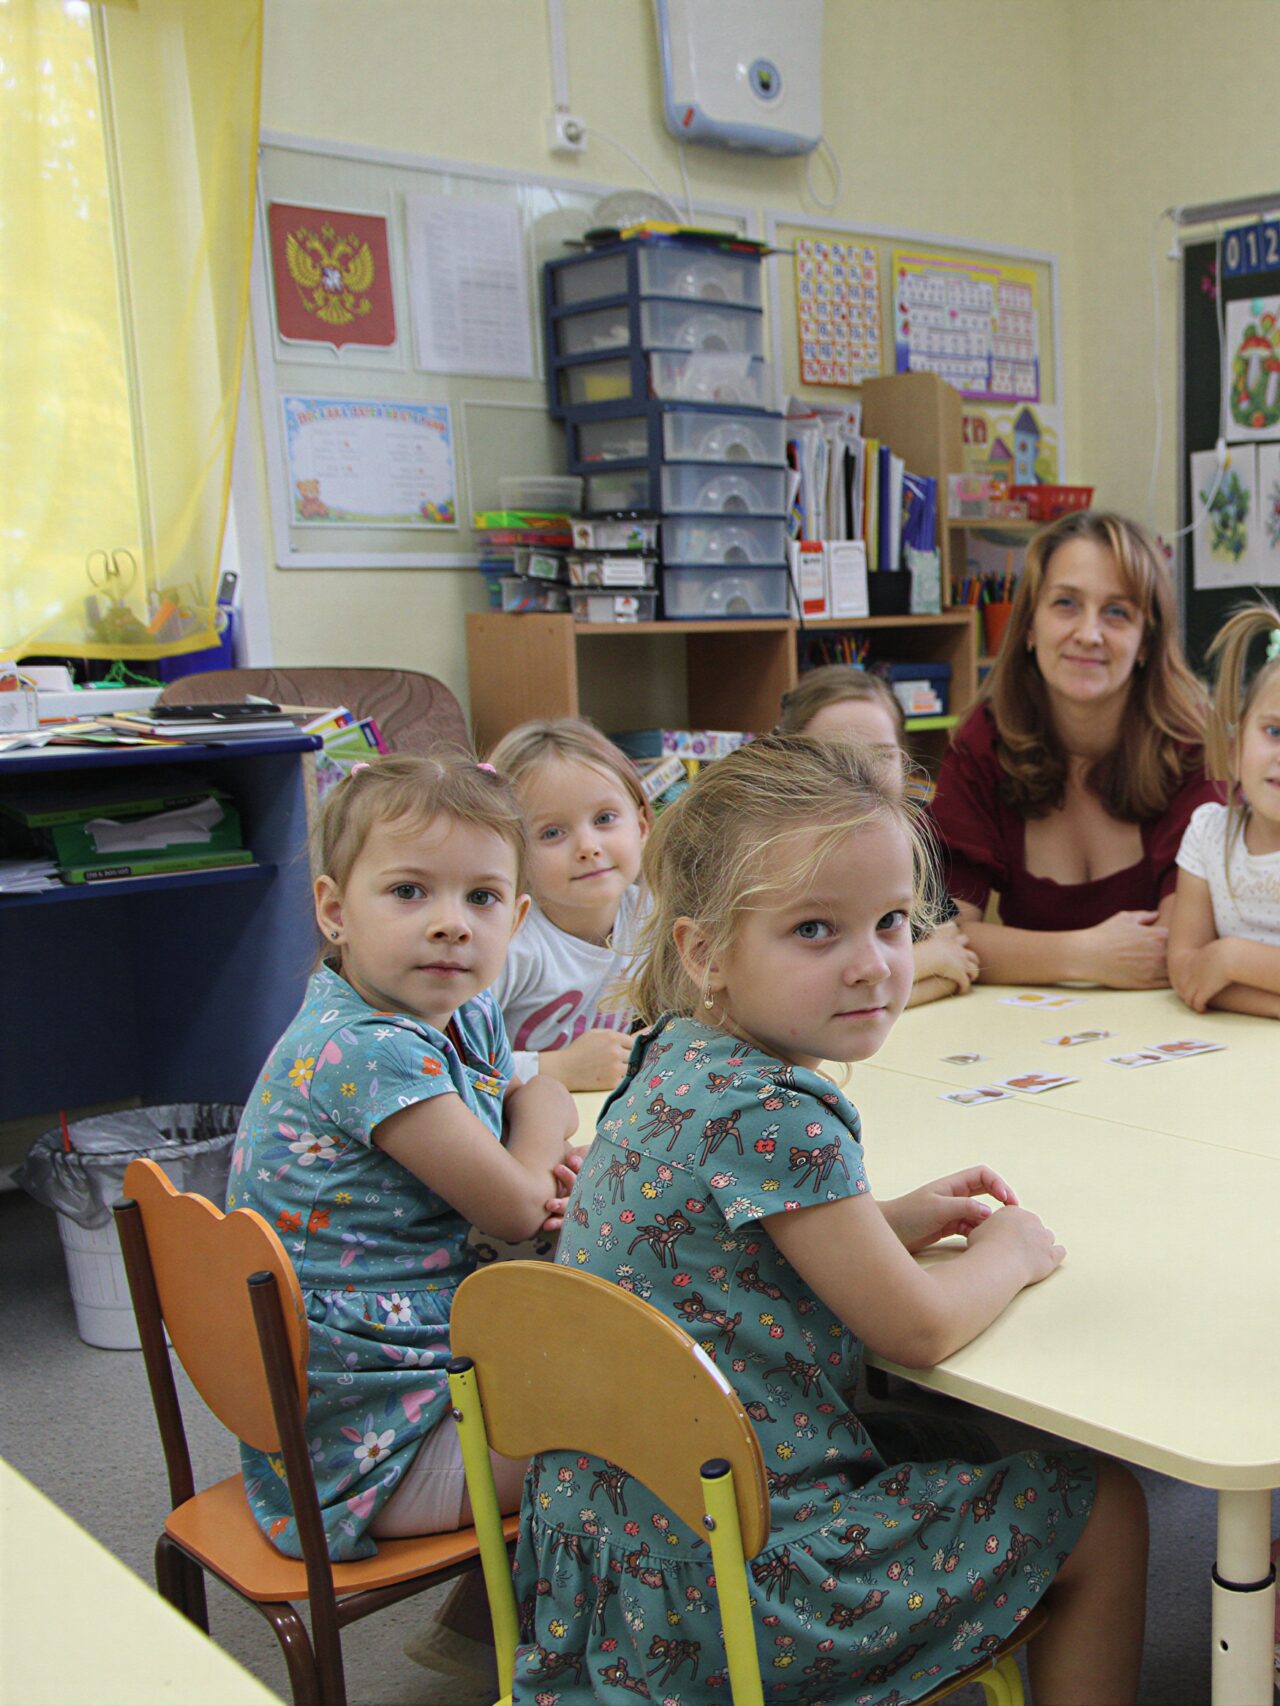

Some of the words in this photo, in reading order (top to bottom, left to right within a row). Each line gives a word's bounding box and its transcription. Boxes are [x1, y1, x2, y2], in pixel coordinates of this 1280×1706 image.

[1226, 236, 1240, 270] 0
[1247, 231, 1258, 265] 1
[1265, 228, 1279, 264] 2
